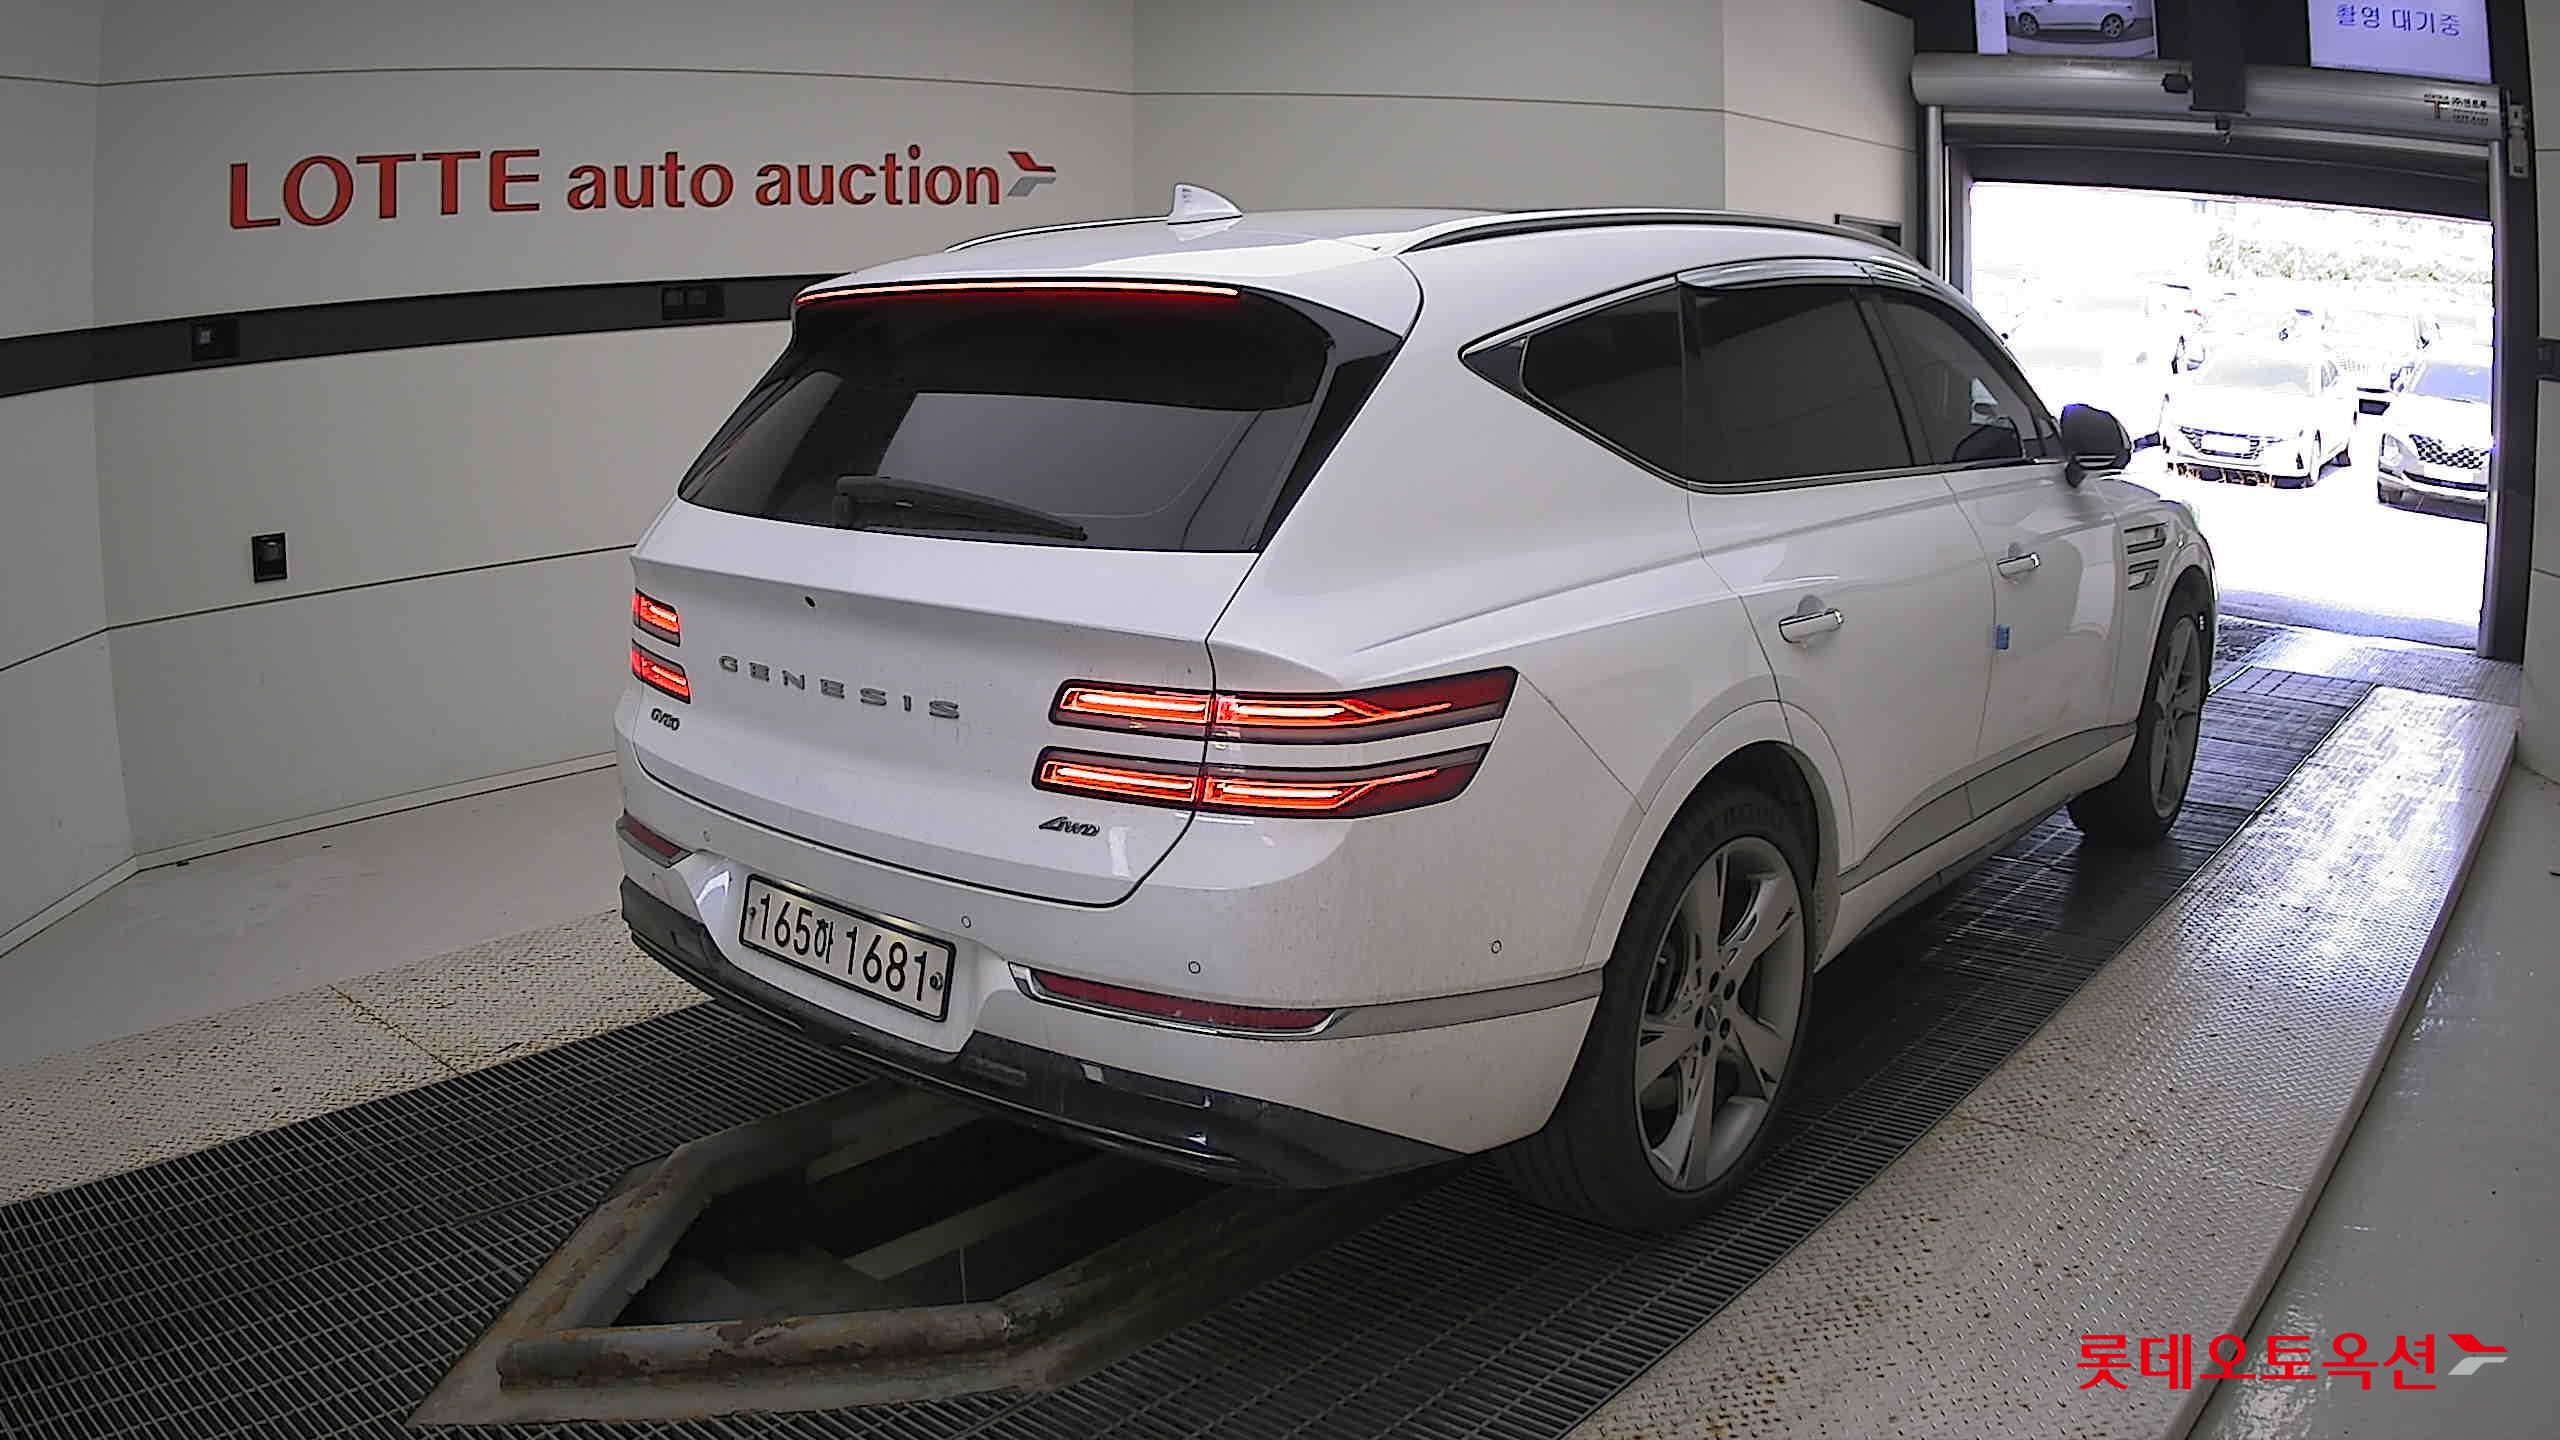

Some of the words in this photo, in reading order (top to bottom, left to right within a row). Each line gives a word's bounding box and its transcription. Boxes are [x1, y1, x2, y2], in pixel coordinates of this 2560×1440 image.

[2338, 4, 2380, 28] 촬영
[2392, 9, 2459, 36] 대기중
[229, 149, 541, 230] LOTTE
[567, 151, 735, 209] auto
[755, 145, 1001, 207] auction
[651, 707, 680, 731] GV80
[718, 654, 960, 719] GENESIS
[760, 893, 834, 964] 165하
[846, 926, 928, 1001] 1681
